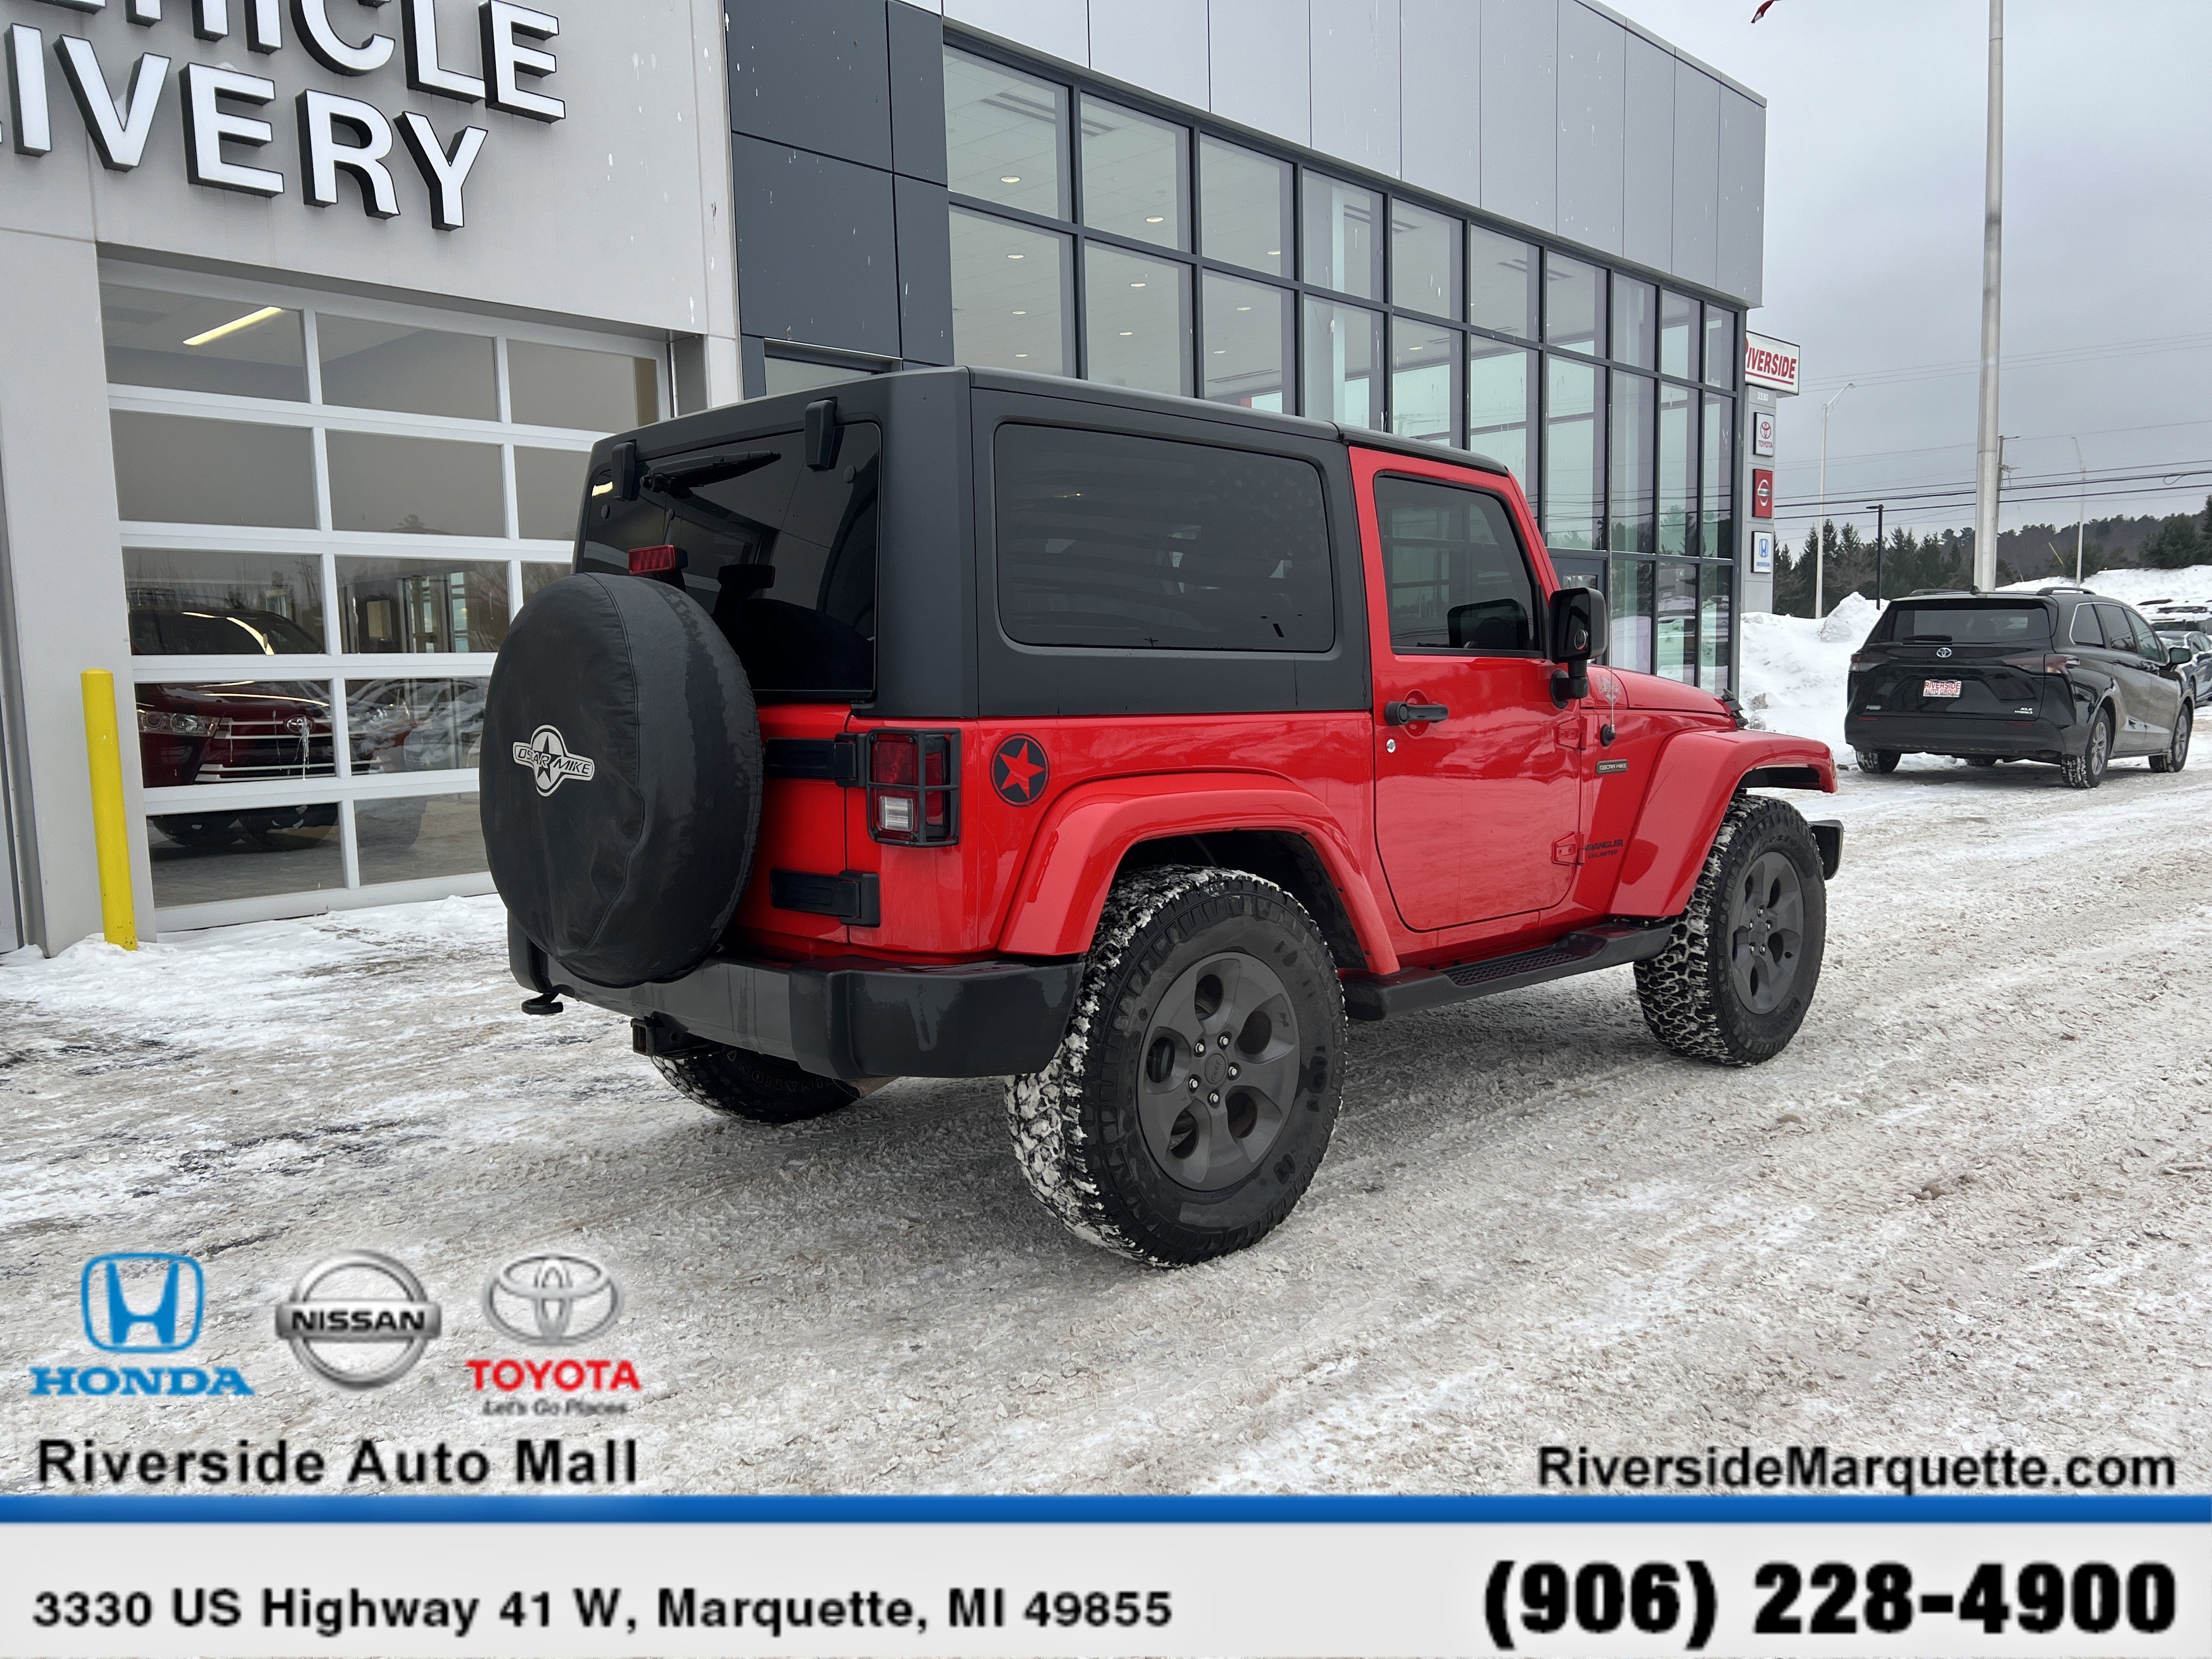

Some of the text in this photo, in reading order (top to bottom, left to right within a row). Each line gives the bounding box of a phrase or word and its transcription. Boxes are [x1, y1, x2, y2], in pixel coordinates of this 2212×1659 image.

[0, 22, 488, 231] IVERY
[1757, 392, 1769, 401] 3330
[1758, 440, 1773, 448] TOYOTA
[518, 748, 591, 775] OSAR MIKE
[1586, 839, 1623, 850] WRANGLER
